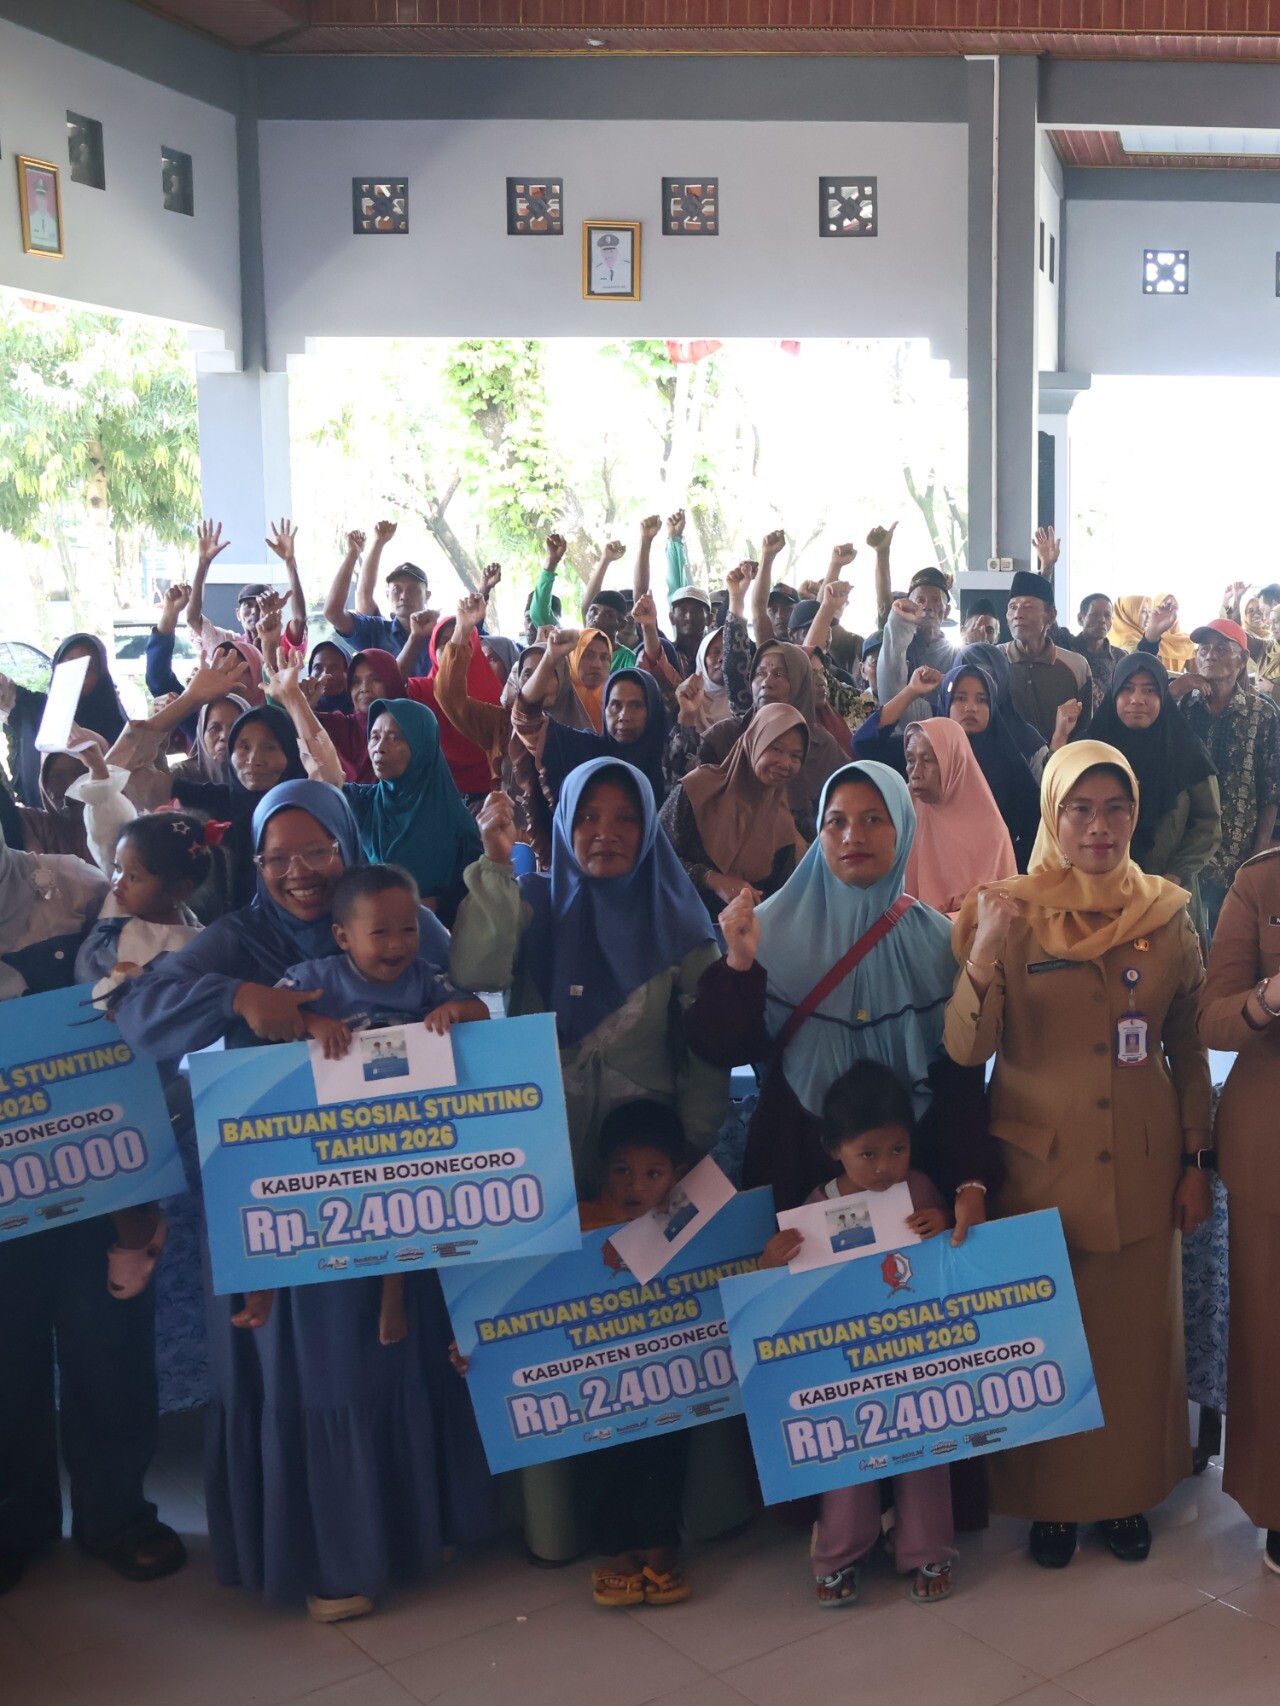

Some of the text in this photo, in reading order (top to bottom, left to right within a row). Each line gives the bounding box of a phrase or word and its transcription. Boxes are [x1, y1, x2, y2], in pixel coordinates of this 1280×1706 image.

[12, 1043, 132, 1088] STUNTING
[0, 1091, 47, 1120] 026
[0, 1108, 114, 1150] JONEGORO
[223, 1087, 538, 1144] BANTUAN SOSIAL STUNTING
[315, 1125, 454, 1161] TAHUN 2026
[262, 1152, 516, 1195] KABUPATEN BOJONEGORO
[246, 1177, 541, 1254] Rp. 2.400.000
[480, 1258, 758, 1341] BANTUAN SOSIAL STUNTIN
[570, 1299, 698, 1346] TAHUN 2026
[757, 1279, 1052, 1361] BANTUAN SOSIAL STUNTING
[522, 1321, 728, 1383] KABUPATEN BOJONEGO
[799, 1341, 1036, 1406] KABUPATEN BOJONEGORO
[846, 1322, 977, 1368] TAHUN 2026
[512, 1348, 738, 1437] Rp. 2.400.0
[787, 1363, 1062, 1461] Rp. 2.400.000
